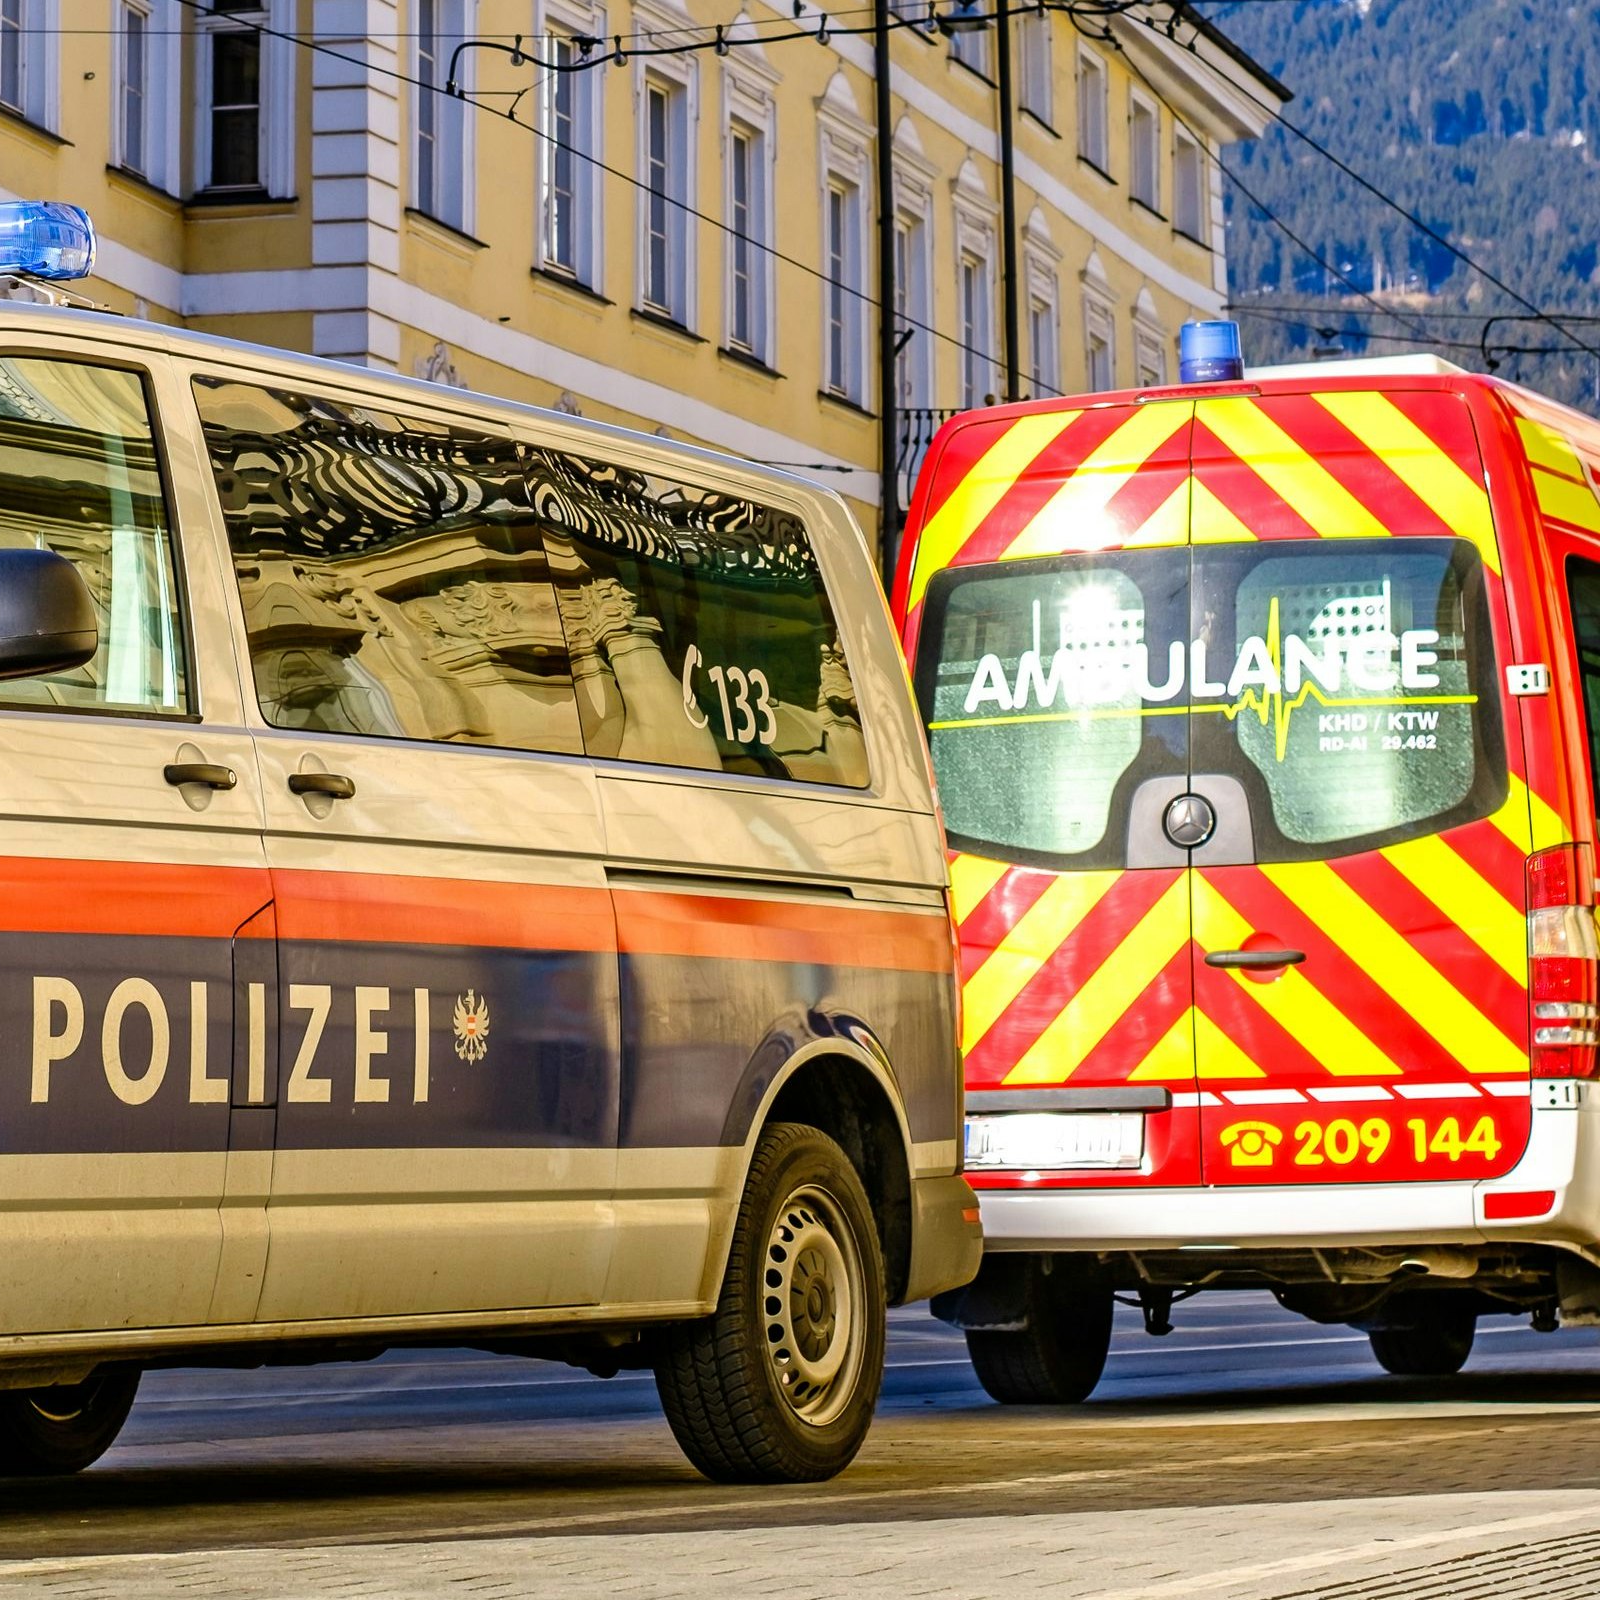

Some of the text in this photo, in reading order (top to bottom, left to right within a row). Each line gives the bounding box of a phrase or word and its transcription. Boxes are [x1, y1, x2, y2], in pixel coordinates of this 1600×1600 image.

[963, 630, 1440, 713] AMULANCE
[708, 666, 777, 744] 133
[1319, 713, 1368, 732] KHD
[1387, 711, 1439, 731] KTW
[1381, 734, 1437, 750] 29.462
[31, 976, 429, 1105] POLIZEI
[1294, 1116, 1502, 1165] 209 144
